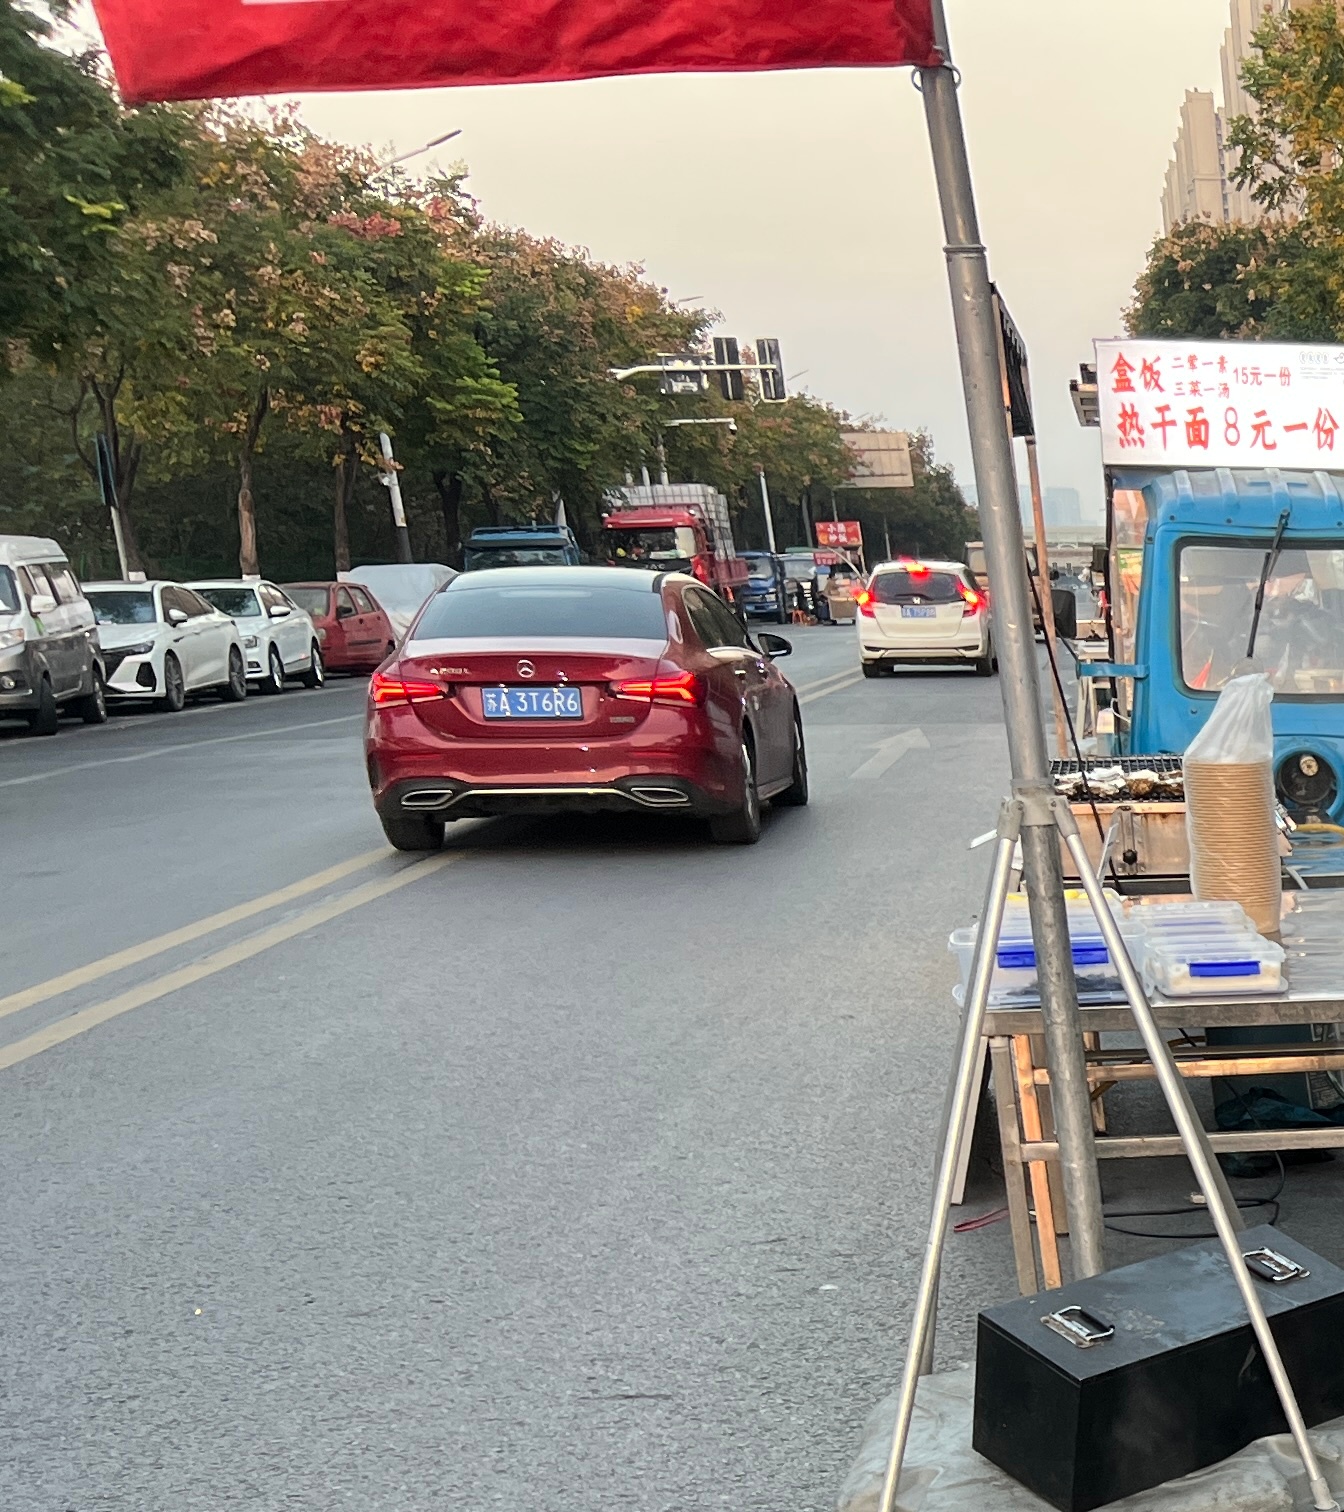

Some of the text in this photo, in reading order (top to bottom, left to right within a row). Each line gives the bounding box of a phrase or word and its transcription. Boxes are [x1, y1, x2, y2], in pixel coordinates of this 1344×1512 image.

[1110, 352, 1165, 394] 盒饭
[1232, 366, 1292, 387] 15元一份
[1173, 380, 1231, 399] 三菜一汤
